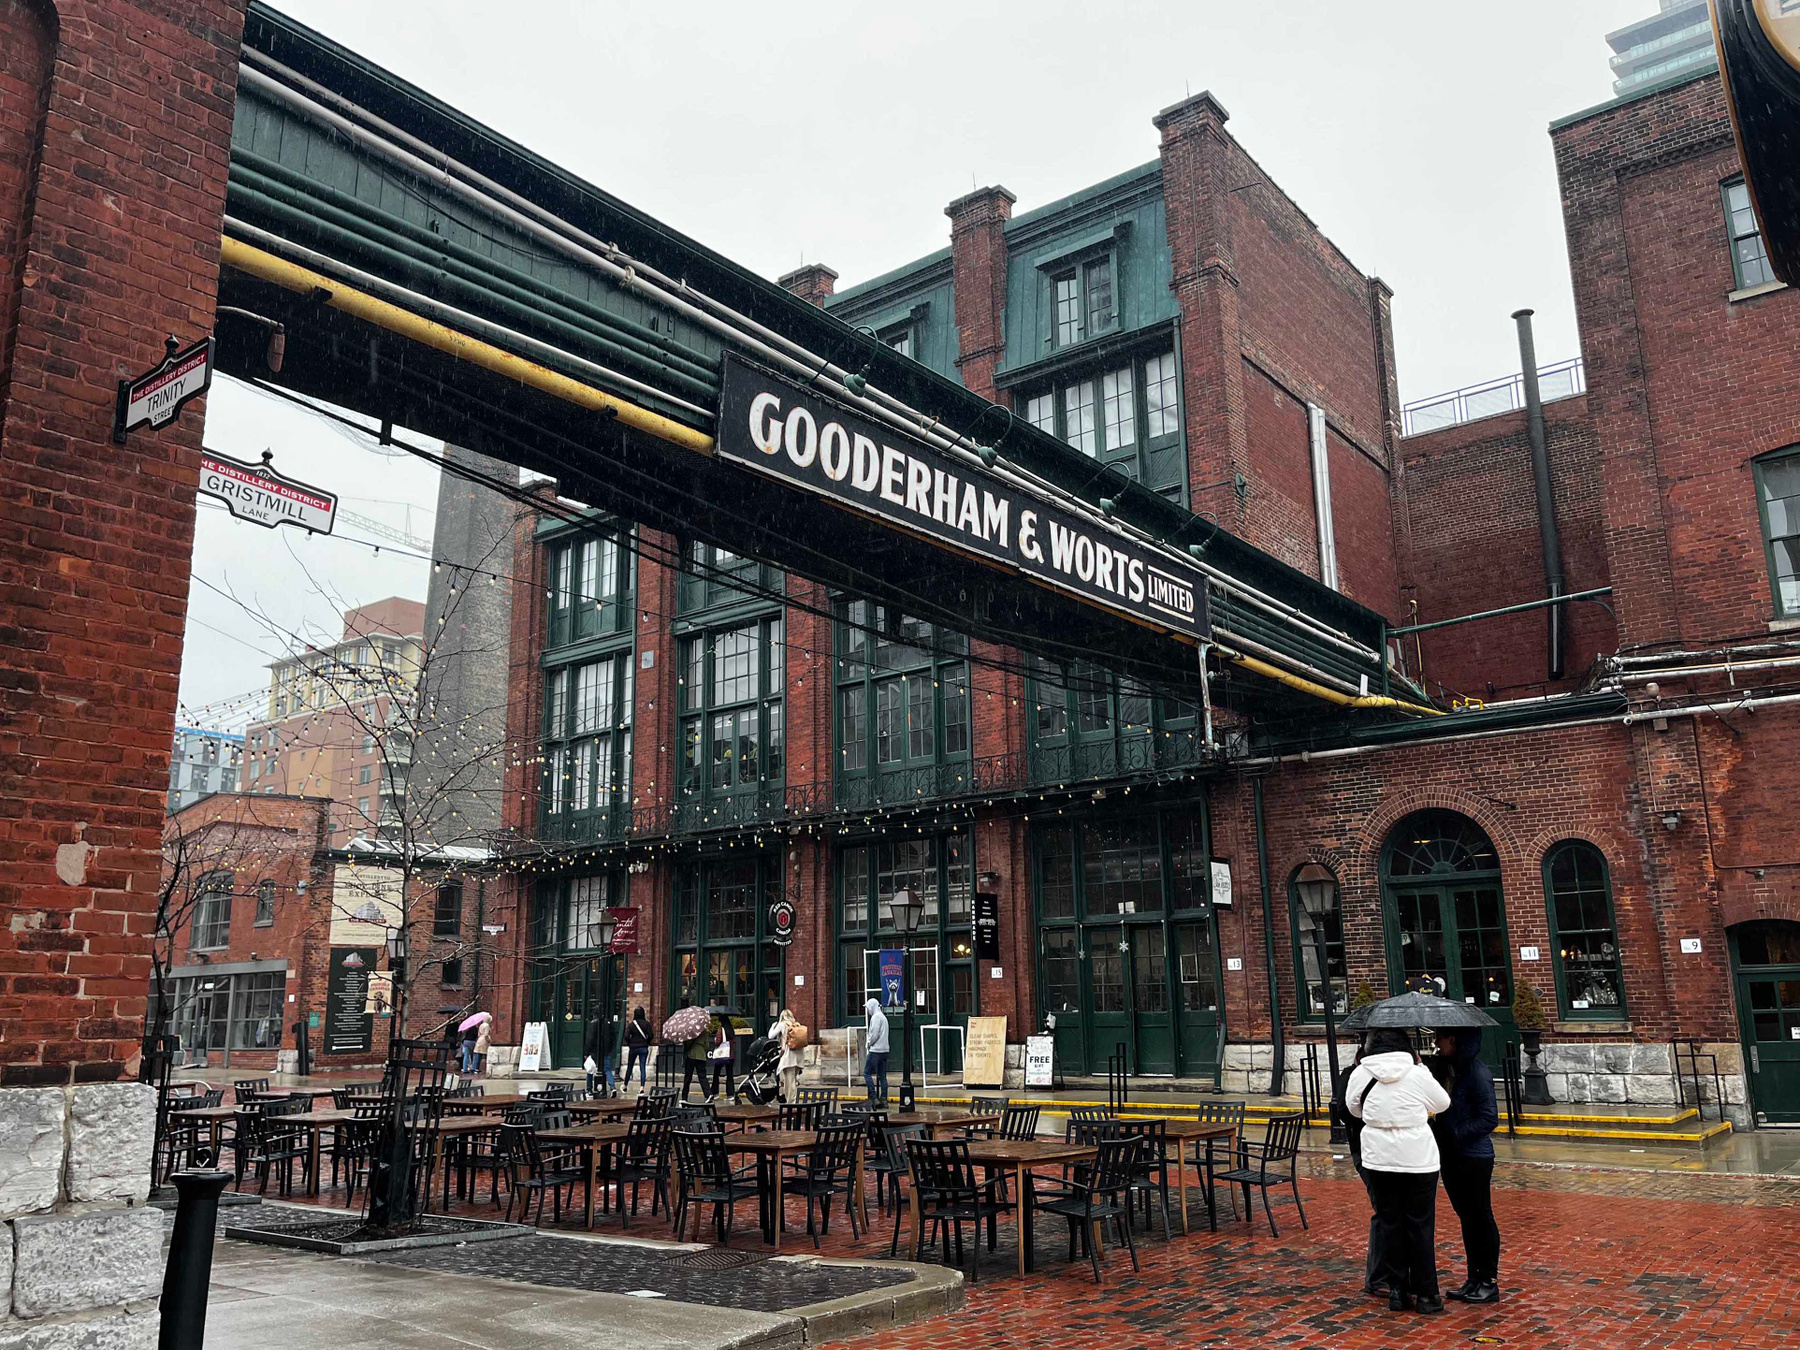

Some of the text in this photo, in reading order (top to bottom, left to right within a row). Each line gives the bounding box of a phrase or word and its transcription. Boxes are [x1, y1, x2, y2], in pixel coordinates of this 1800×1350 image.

[133, 389, 144, 401] THE
[145, 370, 177, 394] DISTILLERY
[177, 354, 205, 375] DISTRICT
[147, 377, 187, 414] TRINITY
[153, 404, 175, 423] STREET
[202, 460, 327, 509] HE DISTILLERY DISTRICT
[255, 470, 270, 480] 1832
[207, 475, 307, 522] GRISTMILL
[748, 391, 1195, 614] GOODERHAM & WORTS LIMITED
[242, 505, 269, 521] LANE
[1528, 949, 1537, 957] 11
[1691, 941, 1698, 950] 9
[1233, 960, 1240, 968] 13
